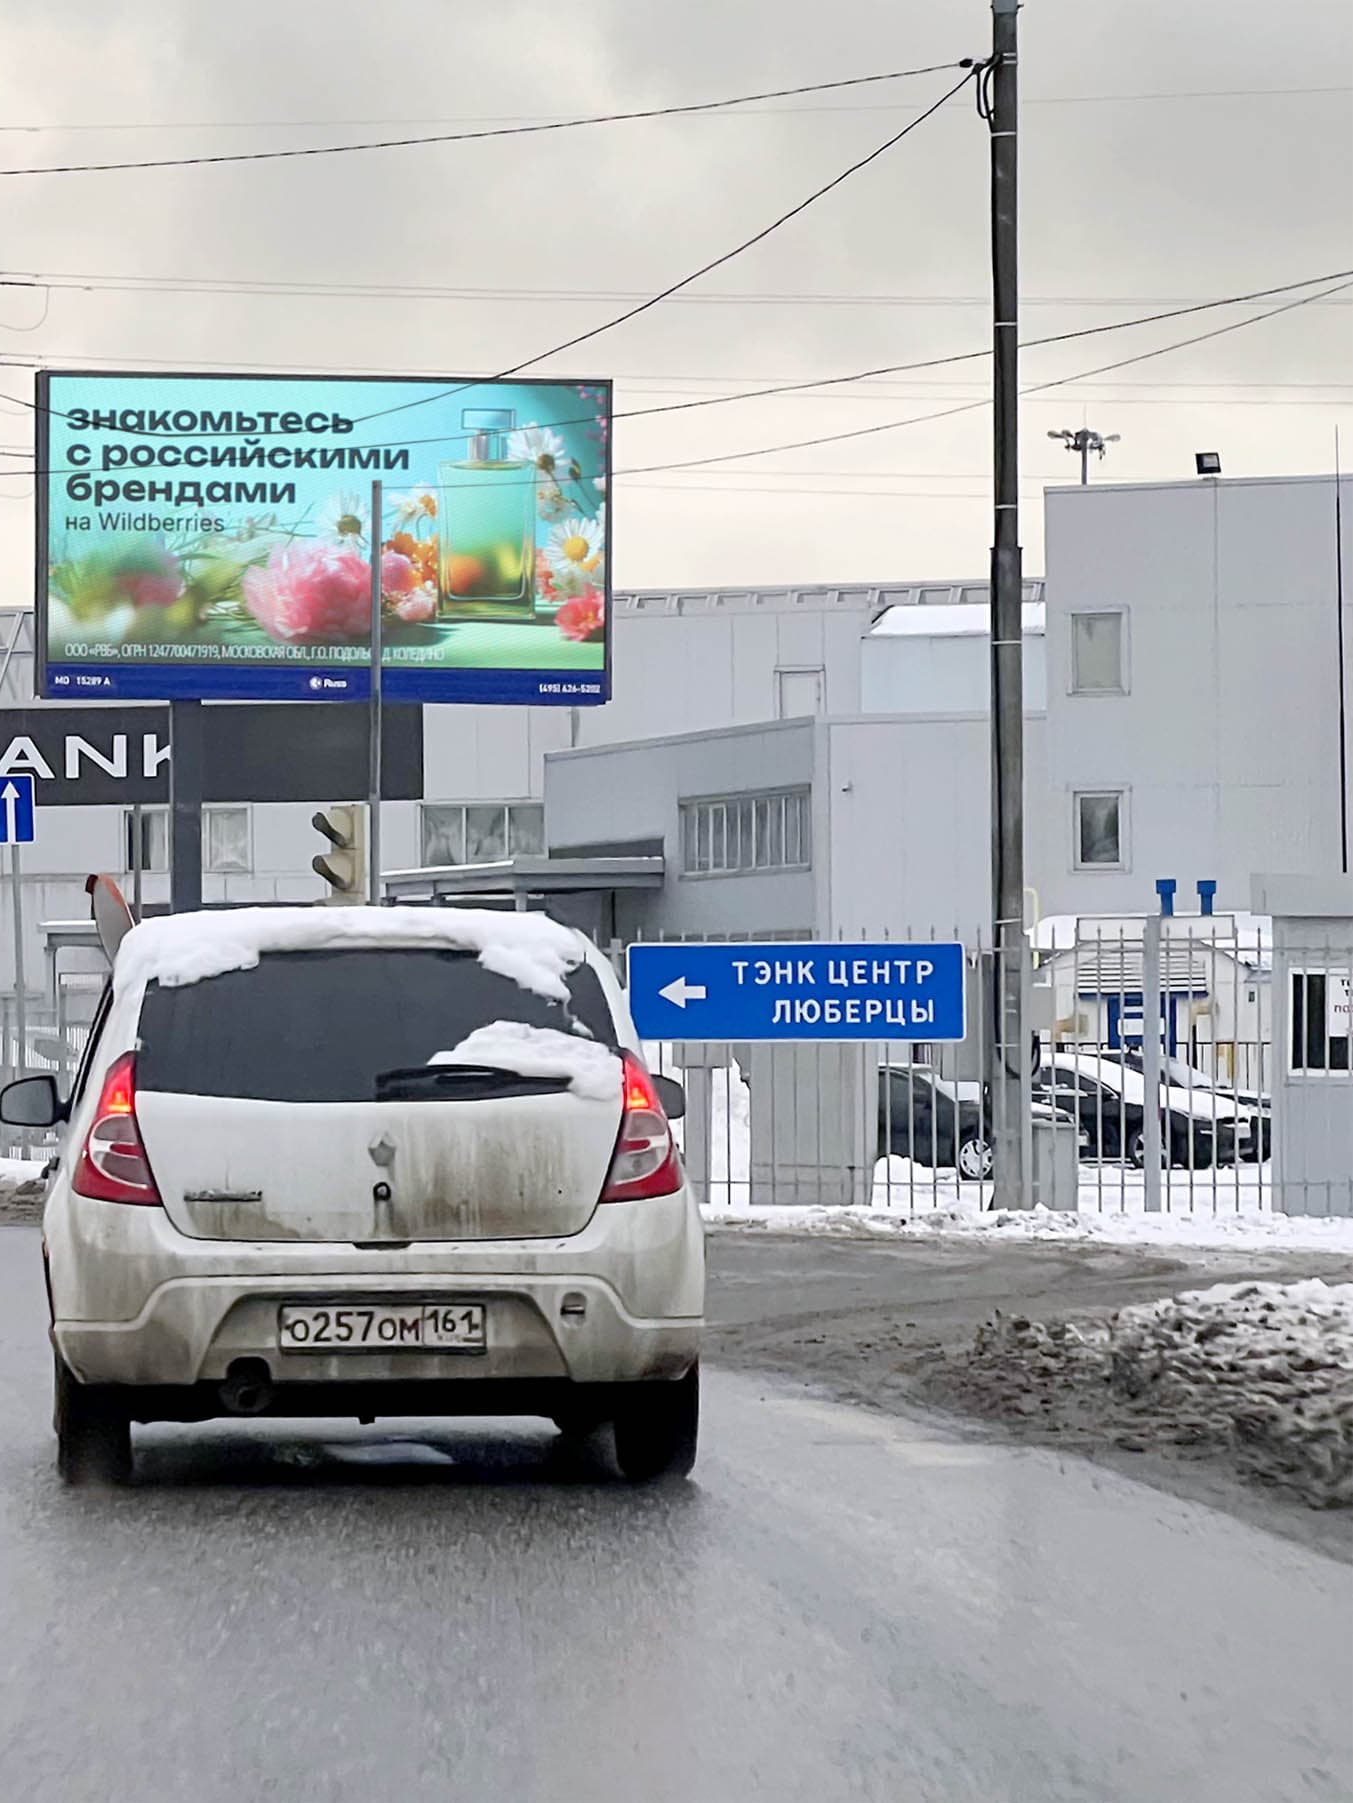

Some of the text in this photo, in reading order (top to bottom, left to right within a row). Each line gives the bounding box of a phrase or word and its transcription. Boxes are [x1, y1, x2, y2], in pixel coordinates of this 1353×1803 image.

[66, 408, 354, 434] знакомьтесь
[66, 438, 409, 471] с российскими
[66, 472, 296, 507] брендами
[65, 512, 225, 533] на Wildberries
[731, 960, 935, 988] ТЭНК ЦЕНТР
[771, 999, 935, 1026] ЛЮБЕРЦЫ
